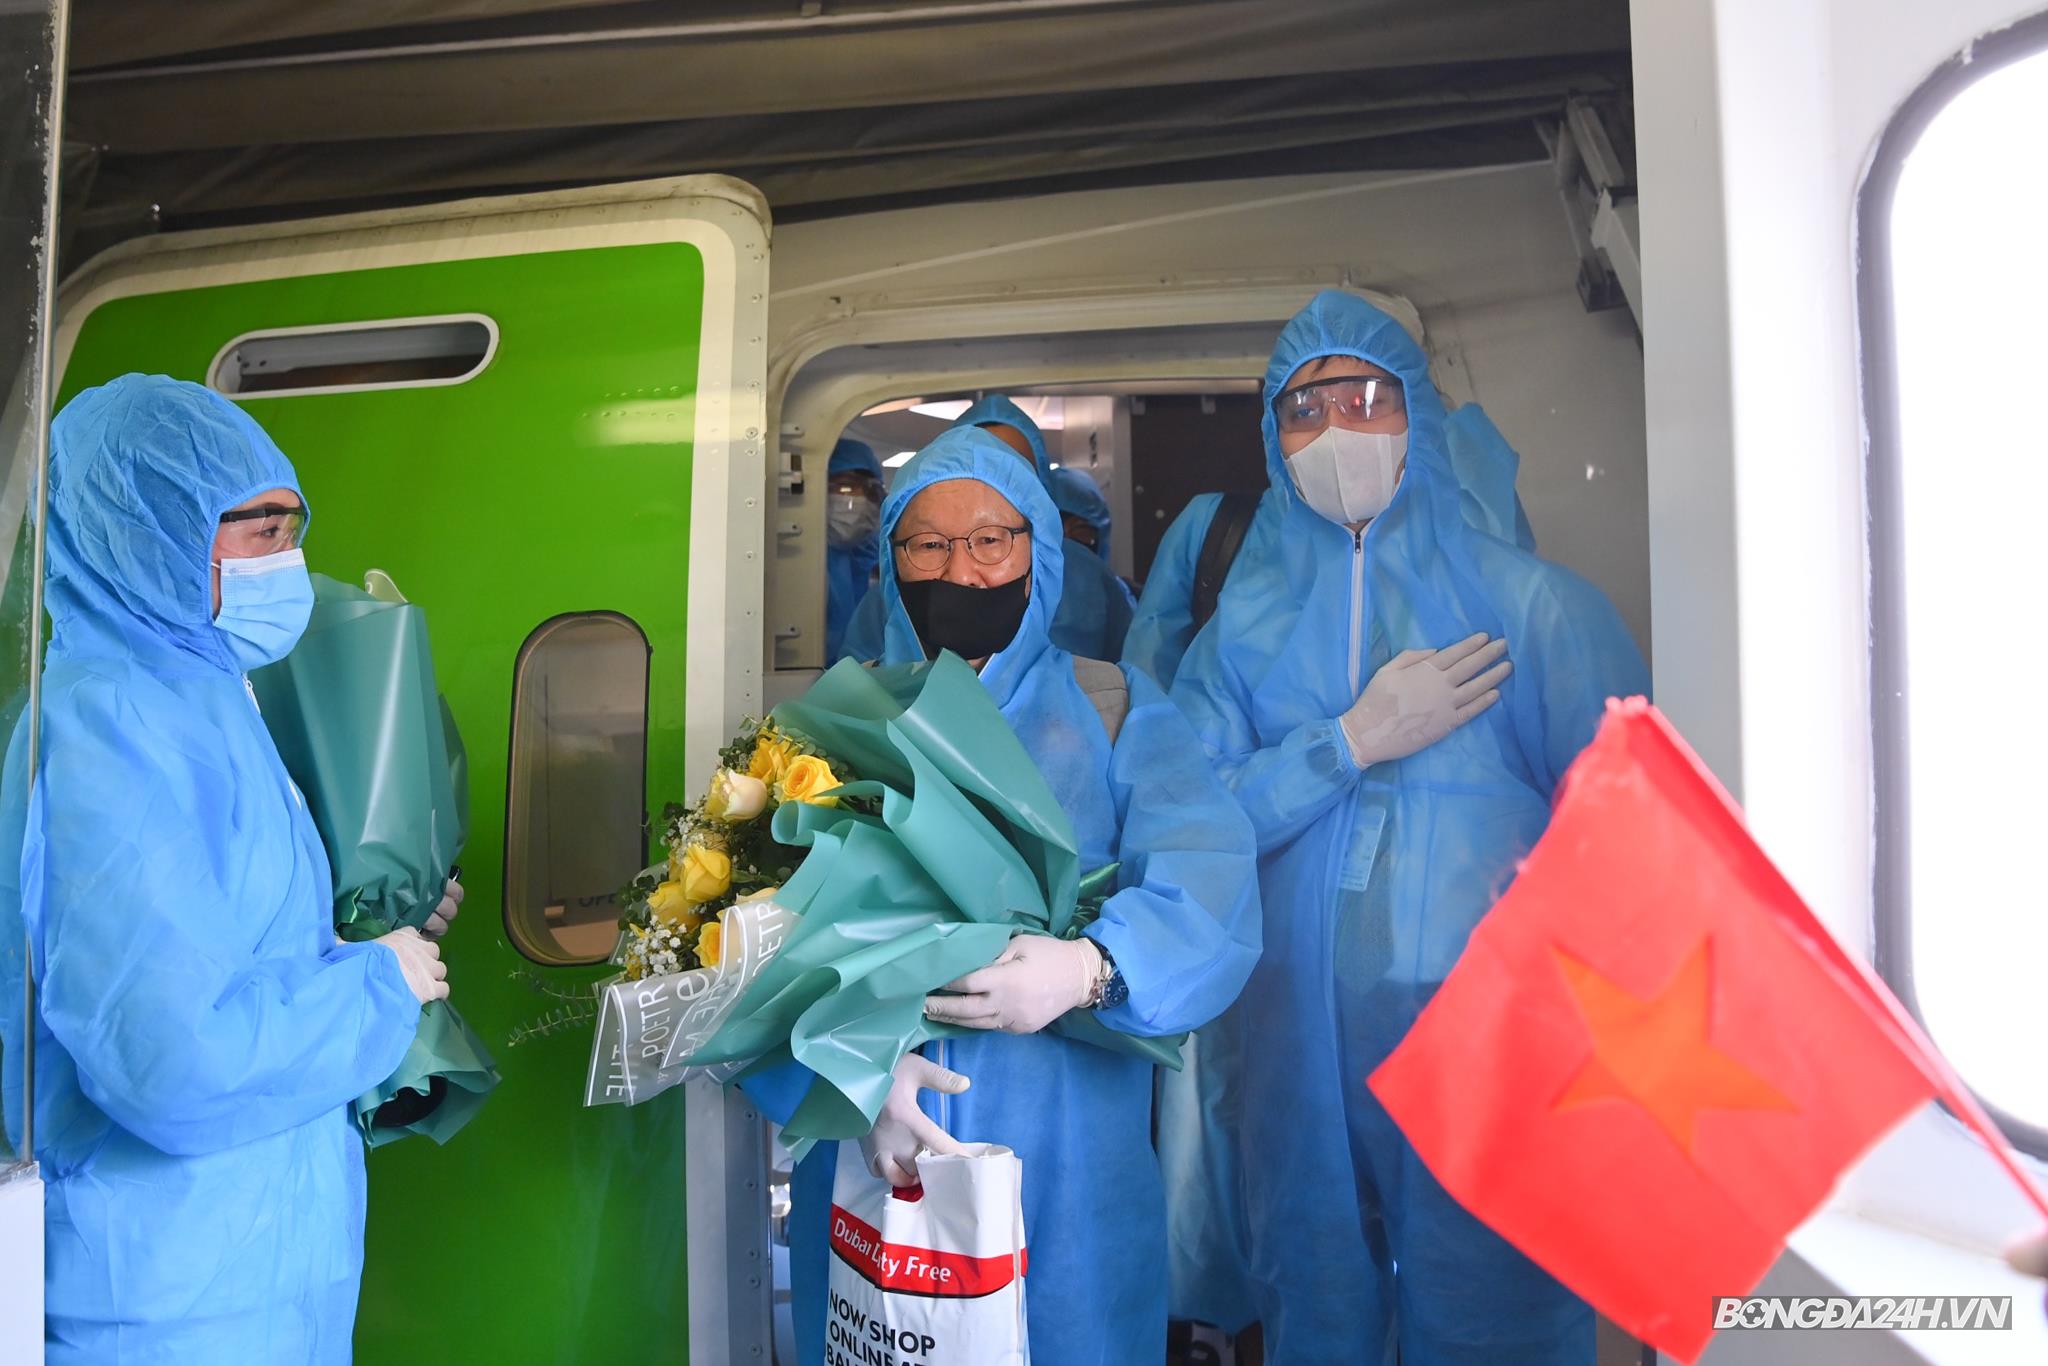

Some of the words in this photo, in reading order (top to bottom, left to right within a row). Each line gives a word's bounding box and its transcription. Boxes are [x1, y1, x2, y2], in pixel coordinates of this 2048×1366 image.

[634, 979, 670, 1058] POETR
[834, 1218, 872, 1256] Dubai
[904, 1255, 952, 1282] Free
[829, 1288, 867, 1333] NOW
[869, 1320, 936, 1357] SHOP
[829, 1320, 894, 1366] ONLINE
